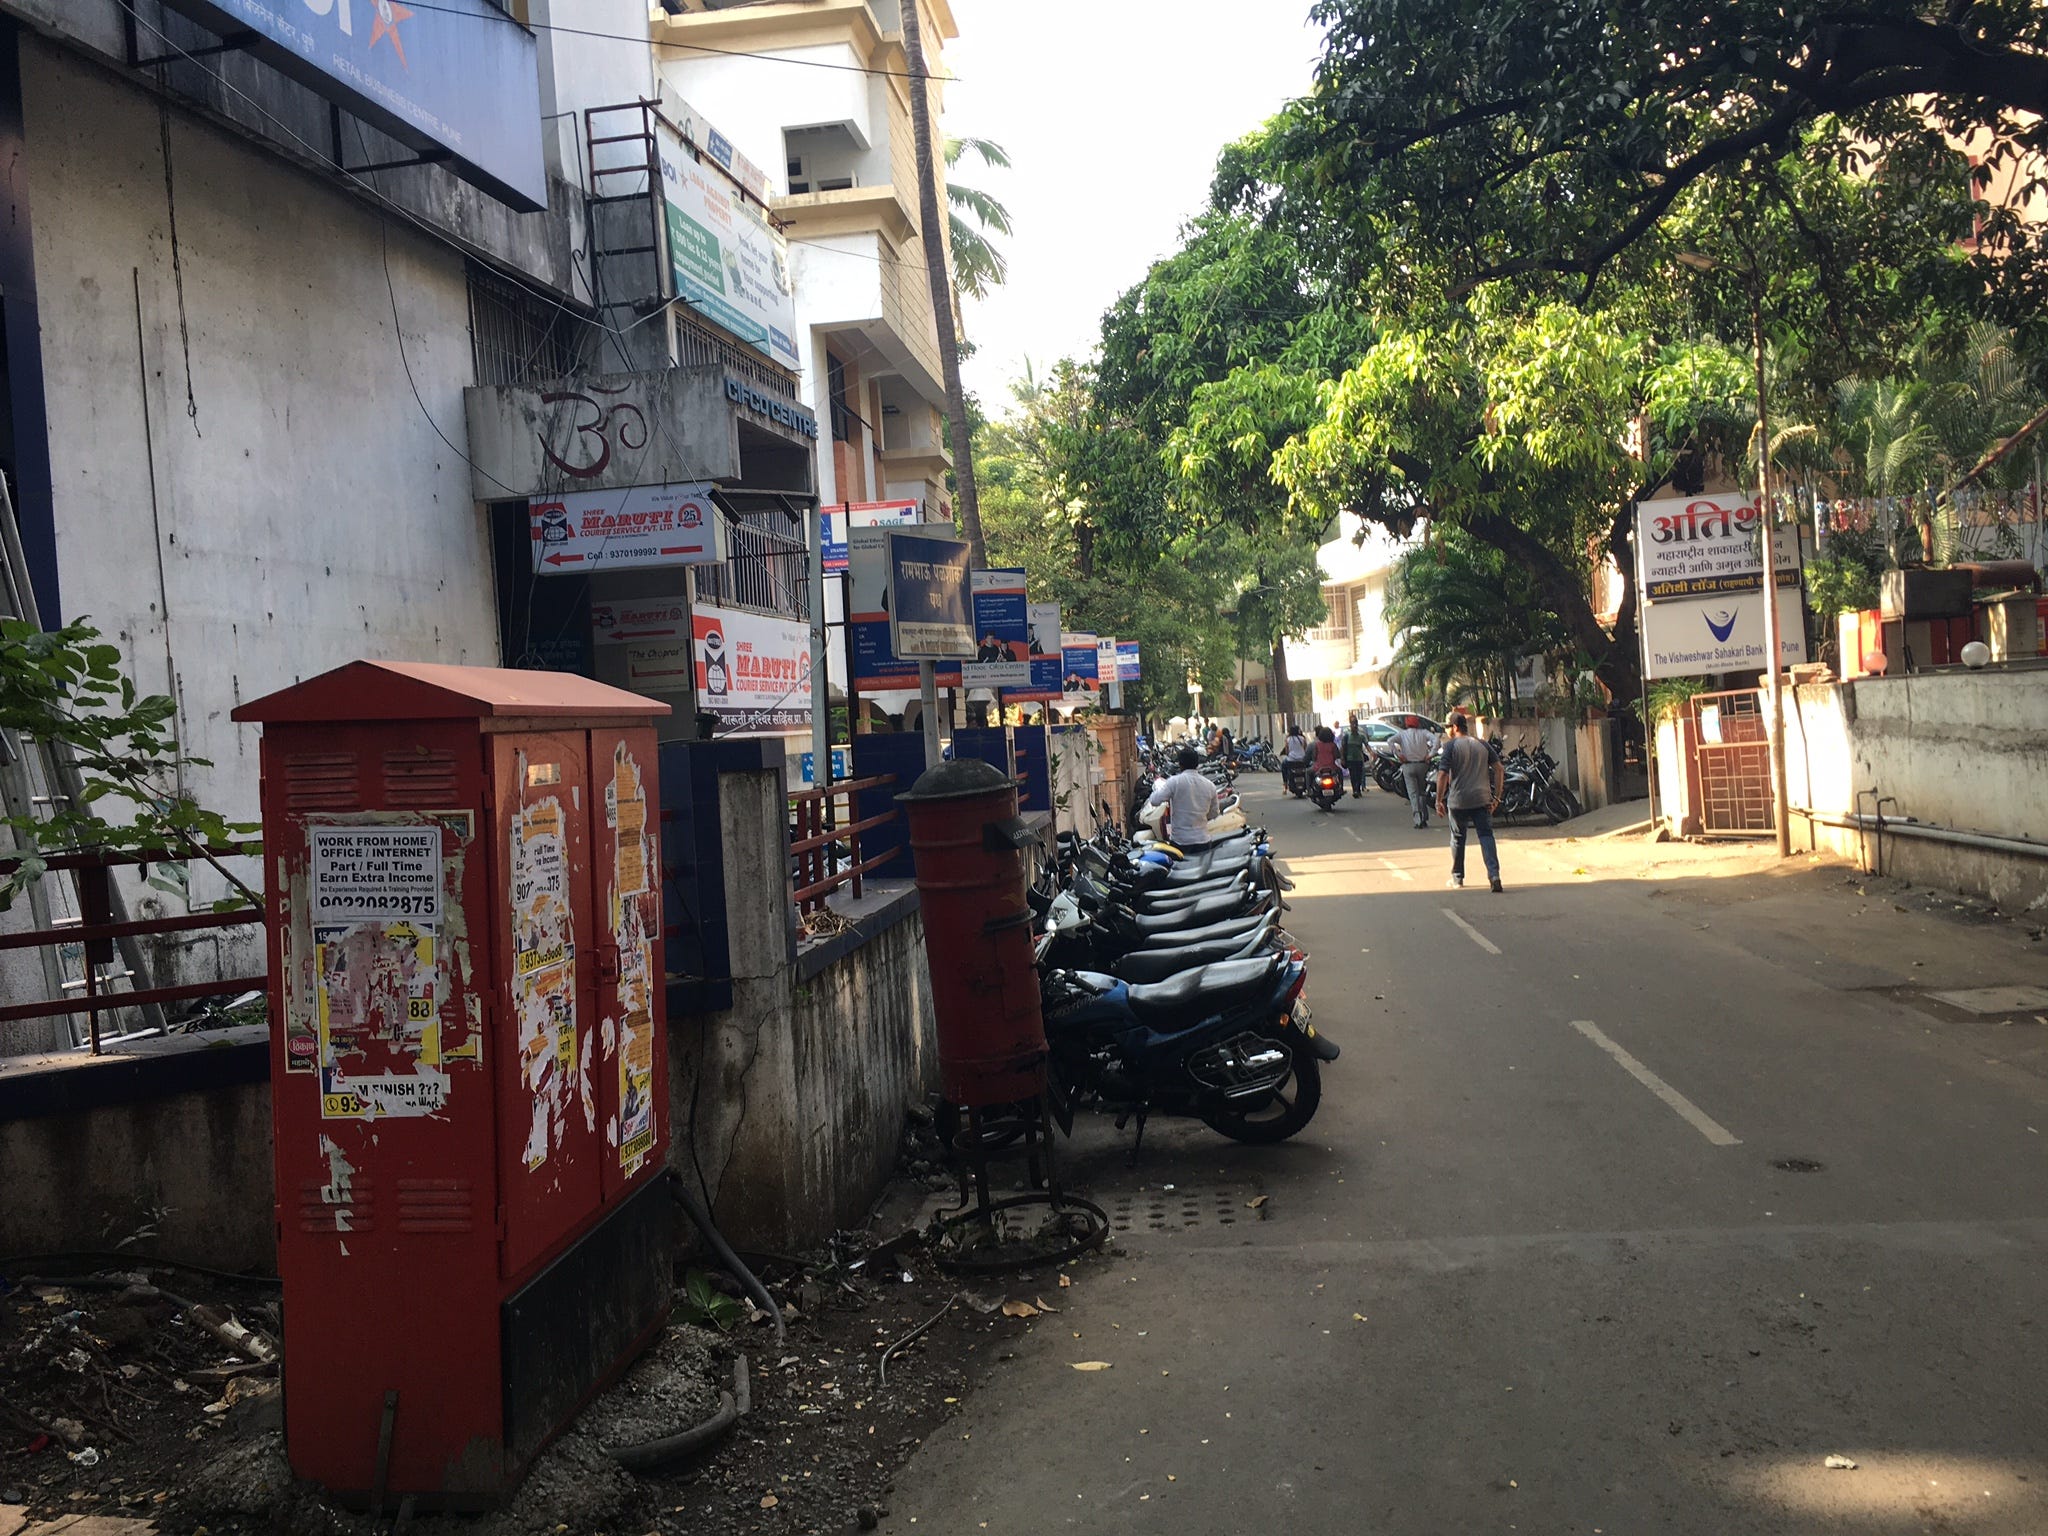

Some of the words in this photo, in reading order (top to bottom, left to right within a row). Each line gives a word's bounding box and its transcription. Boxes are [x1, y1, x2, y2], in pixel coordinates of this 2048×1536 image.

[724, 376, 769, 416] CIFCO
[770, 400, 819, 440] CENTRE
[581, 510, 674, 529] MARUTI
[683, 509, 696, 521] 25
[580, 527, 612, 538] COURIER
[612, 525, 643, 536] SERVICE
[643, 525, 659, 534] PVT.
[659, 523, 674, 532] LTD.
[609, 547, 658, 559] 9370199992
[1689, 560, 1713, 573] आणि
[1652, 580, 1688, 595] अतिथी
[1691, 579, 1716, 592] लॉज
[736, 641, 753, 652] SHREE
[1655, 653, 1668, 664] The
[1668, 650, 1714, 664] Vishweshwar
[1714, 646, 1745, 659] Sahakari
[1746, 644, 1763, 656] Bank
[1782, 641, 1799, 652] Pune
[736, 654, 797, 679] MARUTI
[736, 679, 759, 691] COURIER
[759, 680, 779, 692] SERVICE
[318, 837, 353, 846] WORK
[357, 836, 390, 846] FROM
[393, 836, 427, 845] HOME
[321, 848, 363, 858] OFFICE
[372, 848, 431, 857] INTERNET
[330, 861, 356, 871] Part
[366, 861, 389, 871] Full
[392, 861, 423, 871] Time
[320, 873, 348, 882] Earn
[352, 873, 385, 882] Extra
[389, 872, 434, 882] Income
[329, 886, 357, 894] Experience
